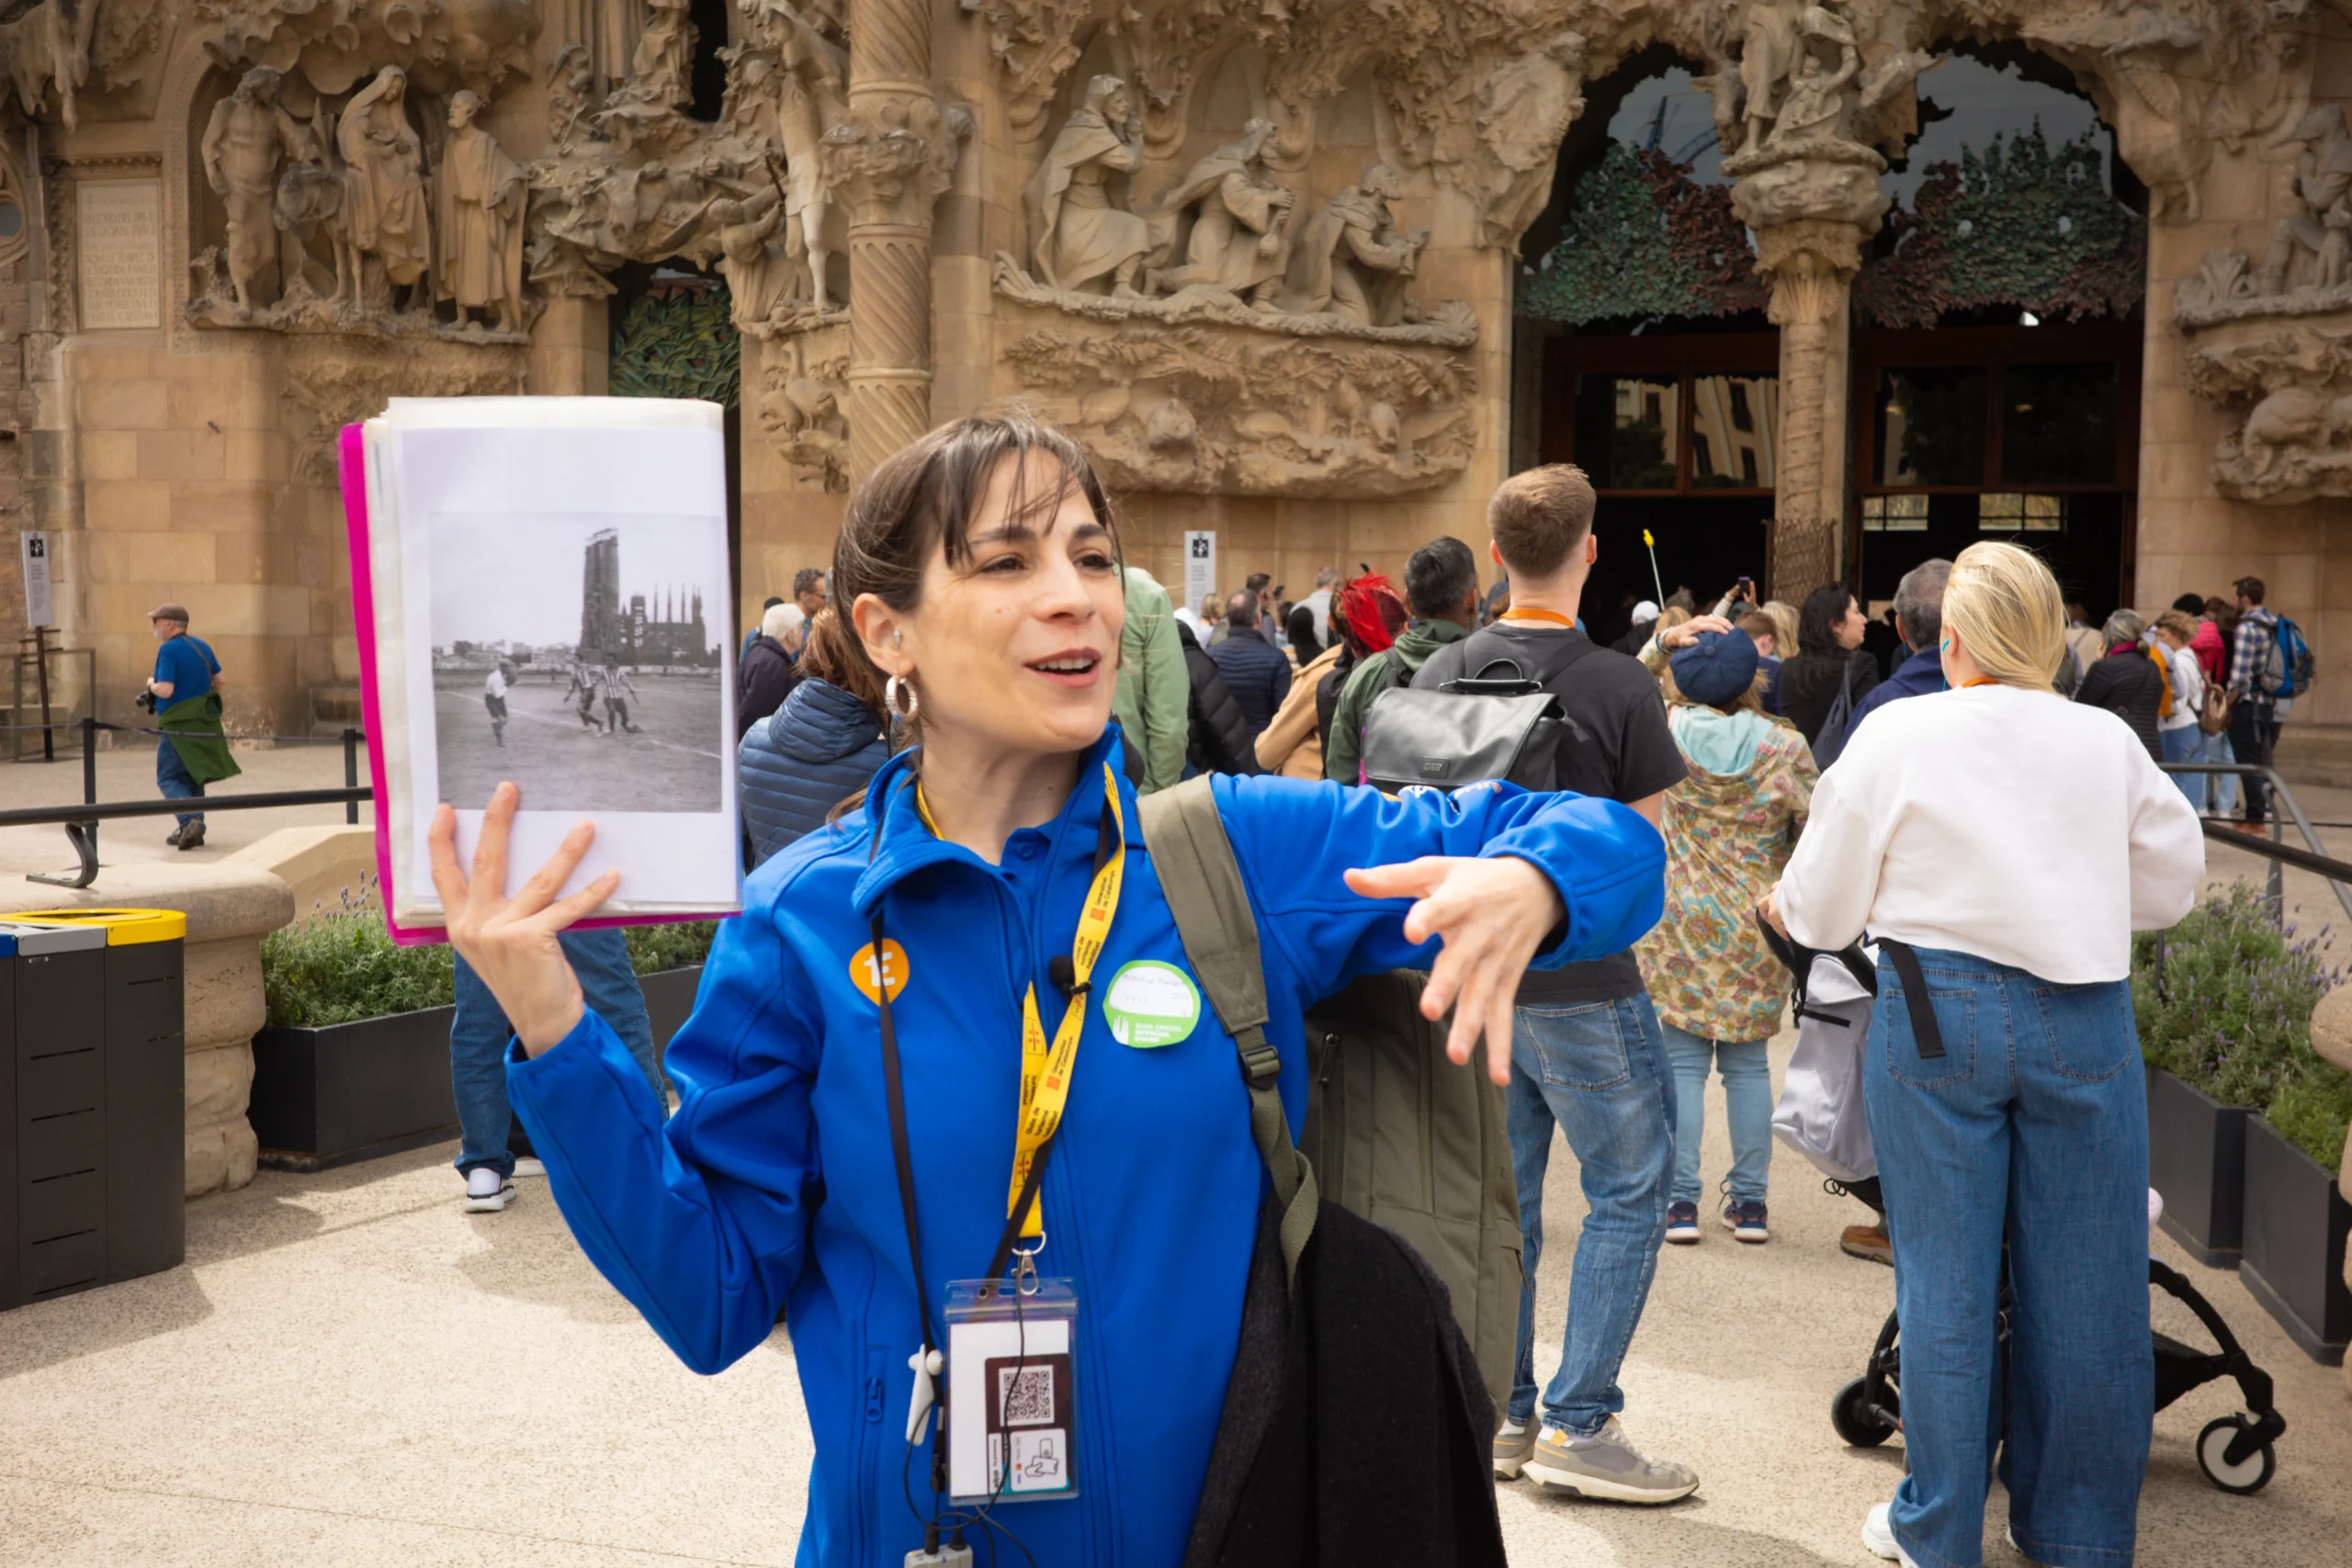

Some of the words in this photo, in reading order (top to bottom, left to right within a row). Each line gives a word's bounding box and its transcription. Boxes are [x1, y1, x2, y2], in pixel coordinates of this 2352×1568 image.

[1094, 877, 1107, 906] Generalitat
[1104, 870, 1115, 899] Catalunya
[1102, 900, 1108, 908] de
[1079, 936, 1084, 945] de
[1086, 942, 1101, 969] habilitat
[1051, 1039, 1066, 1074] Generalitat
[1058, 1068, 1064, 1077] de
[1061, 1036, 1073, 1067] Catalunya
[1033, 1107, 1040, 1116] de
